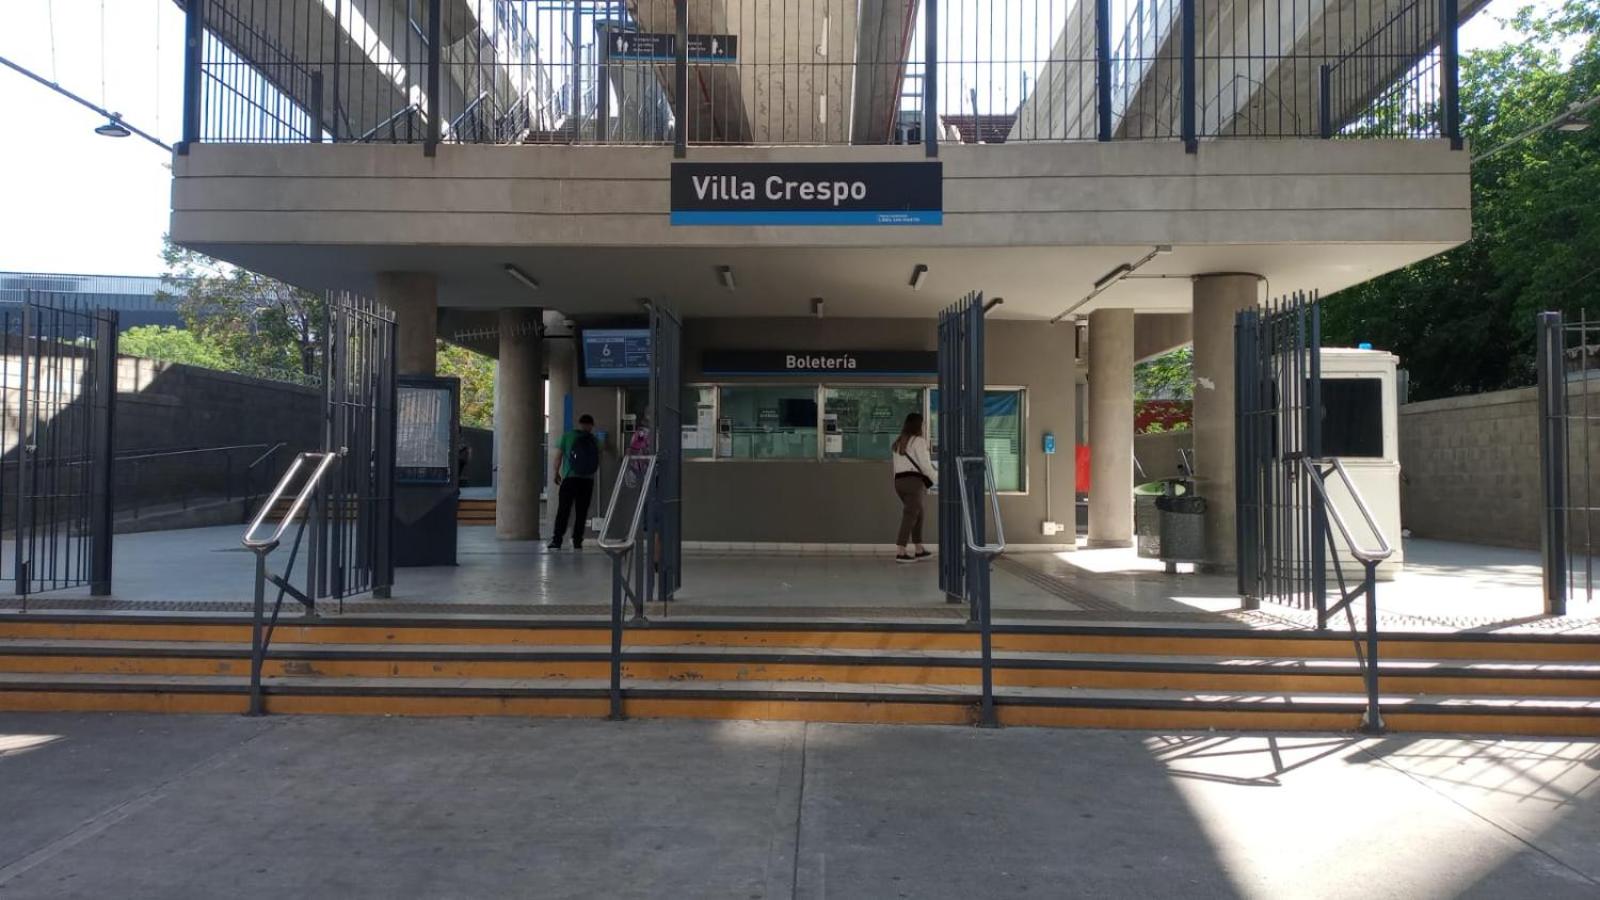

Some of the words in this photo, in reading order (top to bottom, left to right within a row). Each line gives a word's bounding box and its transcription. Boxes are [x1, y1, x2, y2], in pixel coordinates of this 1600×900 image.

[691, 175, 756, 200] Villa
[765, 175, 867, 206] Crespo
[602, 343, 611, 357] 6
[786, 354, 856, 369] Boletería
